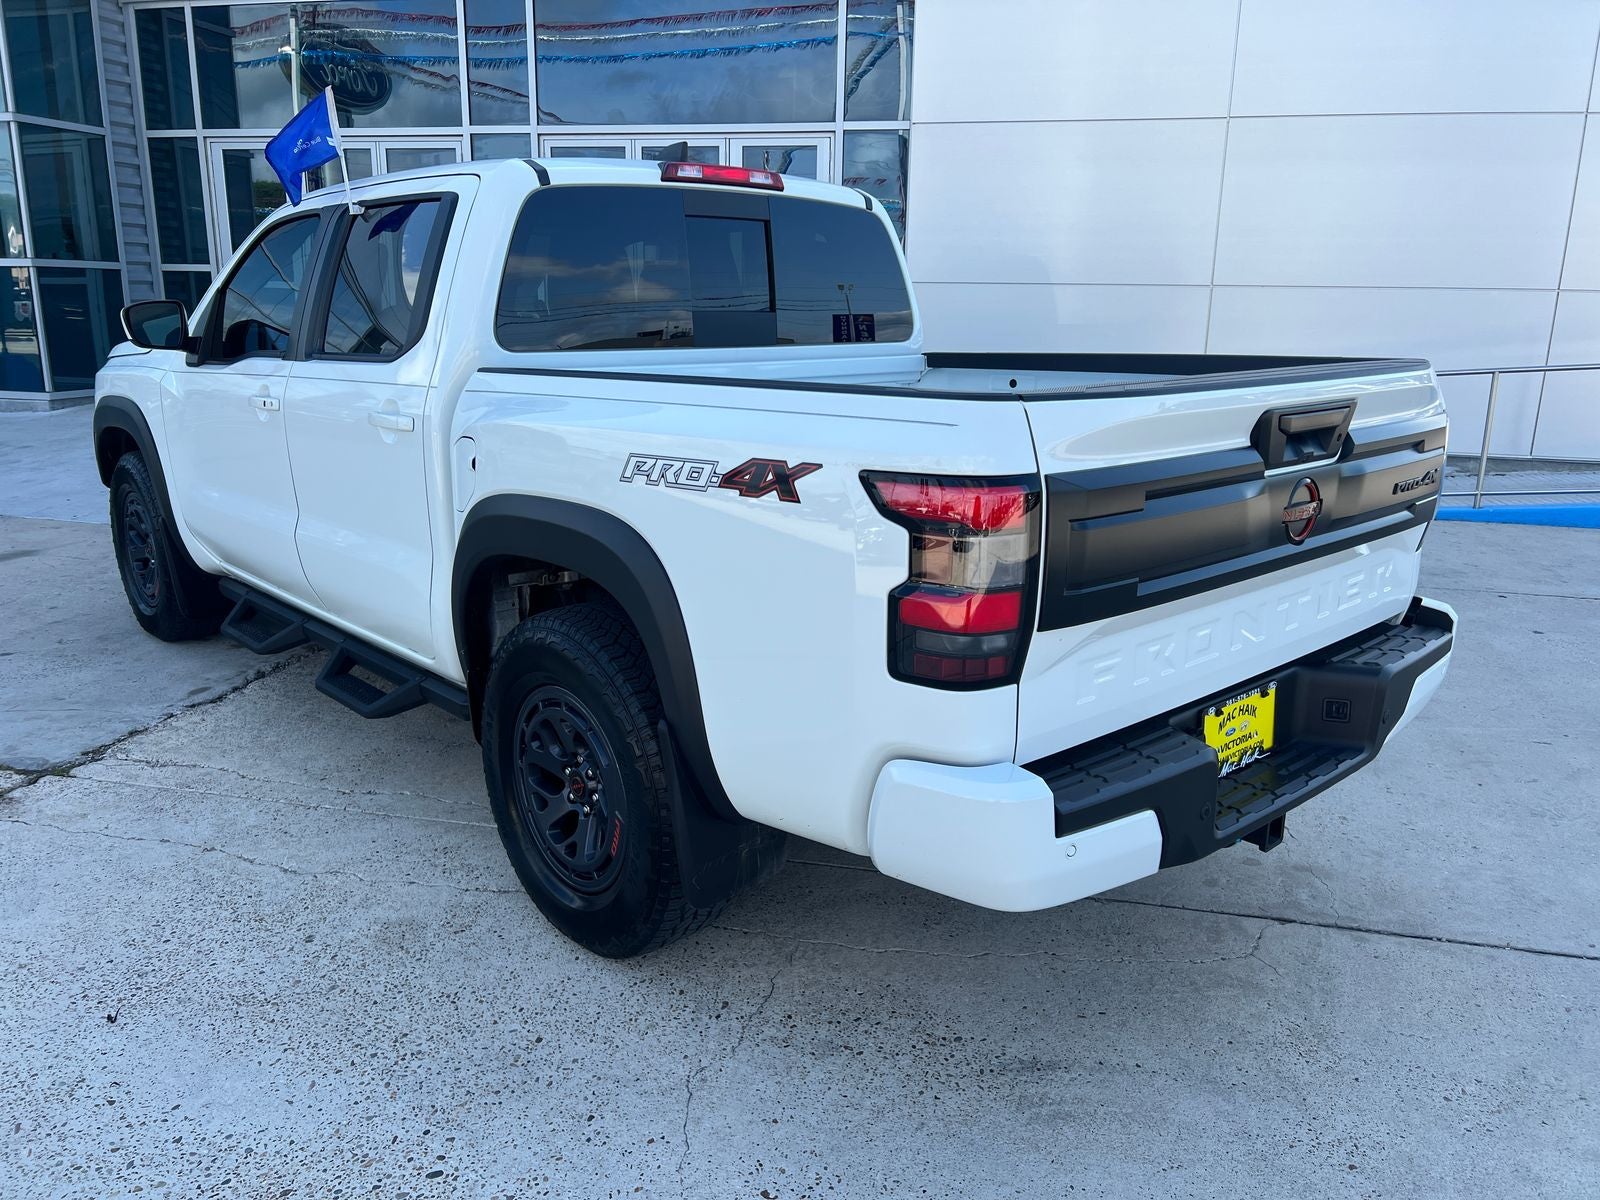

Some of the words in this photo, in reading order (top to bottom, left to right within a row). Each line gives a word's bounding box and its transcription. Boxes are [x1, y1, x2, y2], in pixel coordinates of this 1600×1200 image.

[619, 452, 824, 504] PRO-4X
[1077, 563, 1394, 705] FRONTIER
[1218, 707, 1237, 735] MAC
[1238, 704, 1258, 719] HAIK
[1220, 732, 1254, 754] VICTORIA
